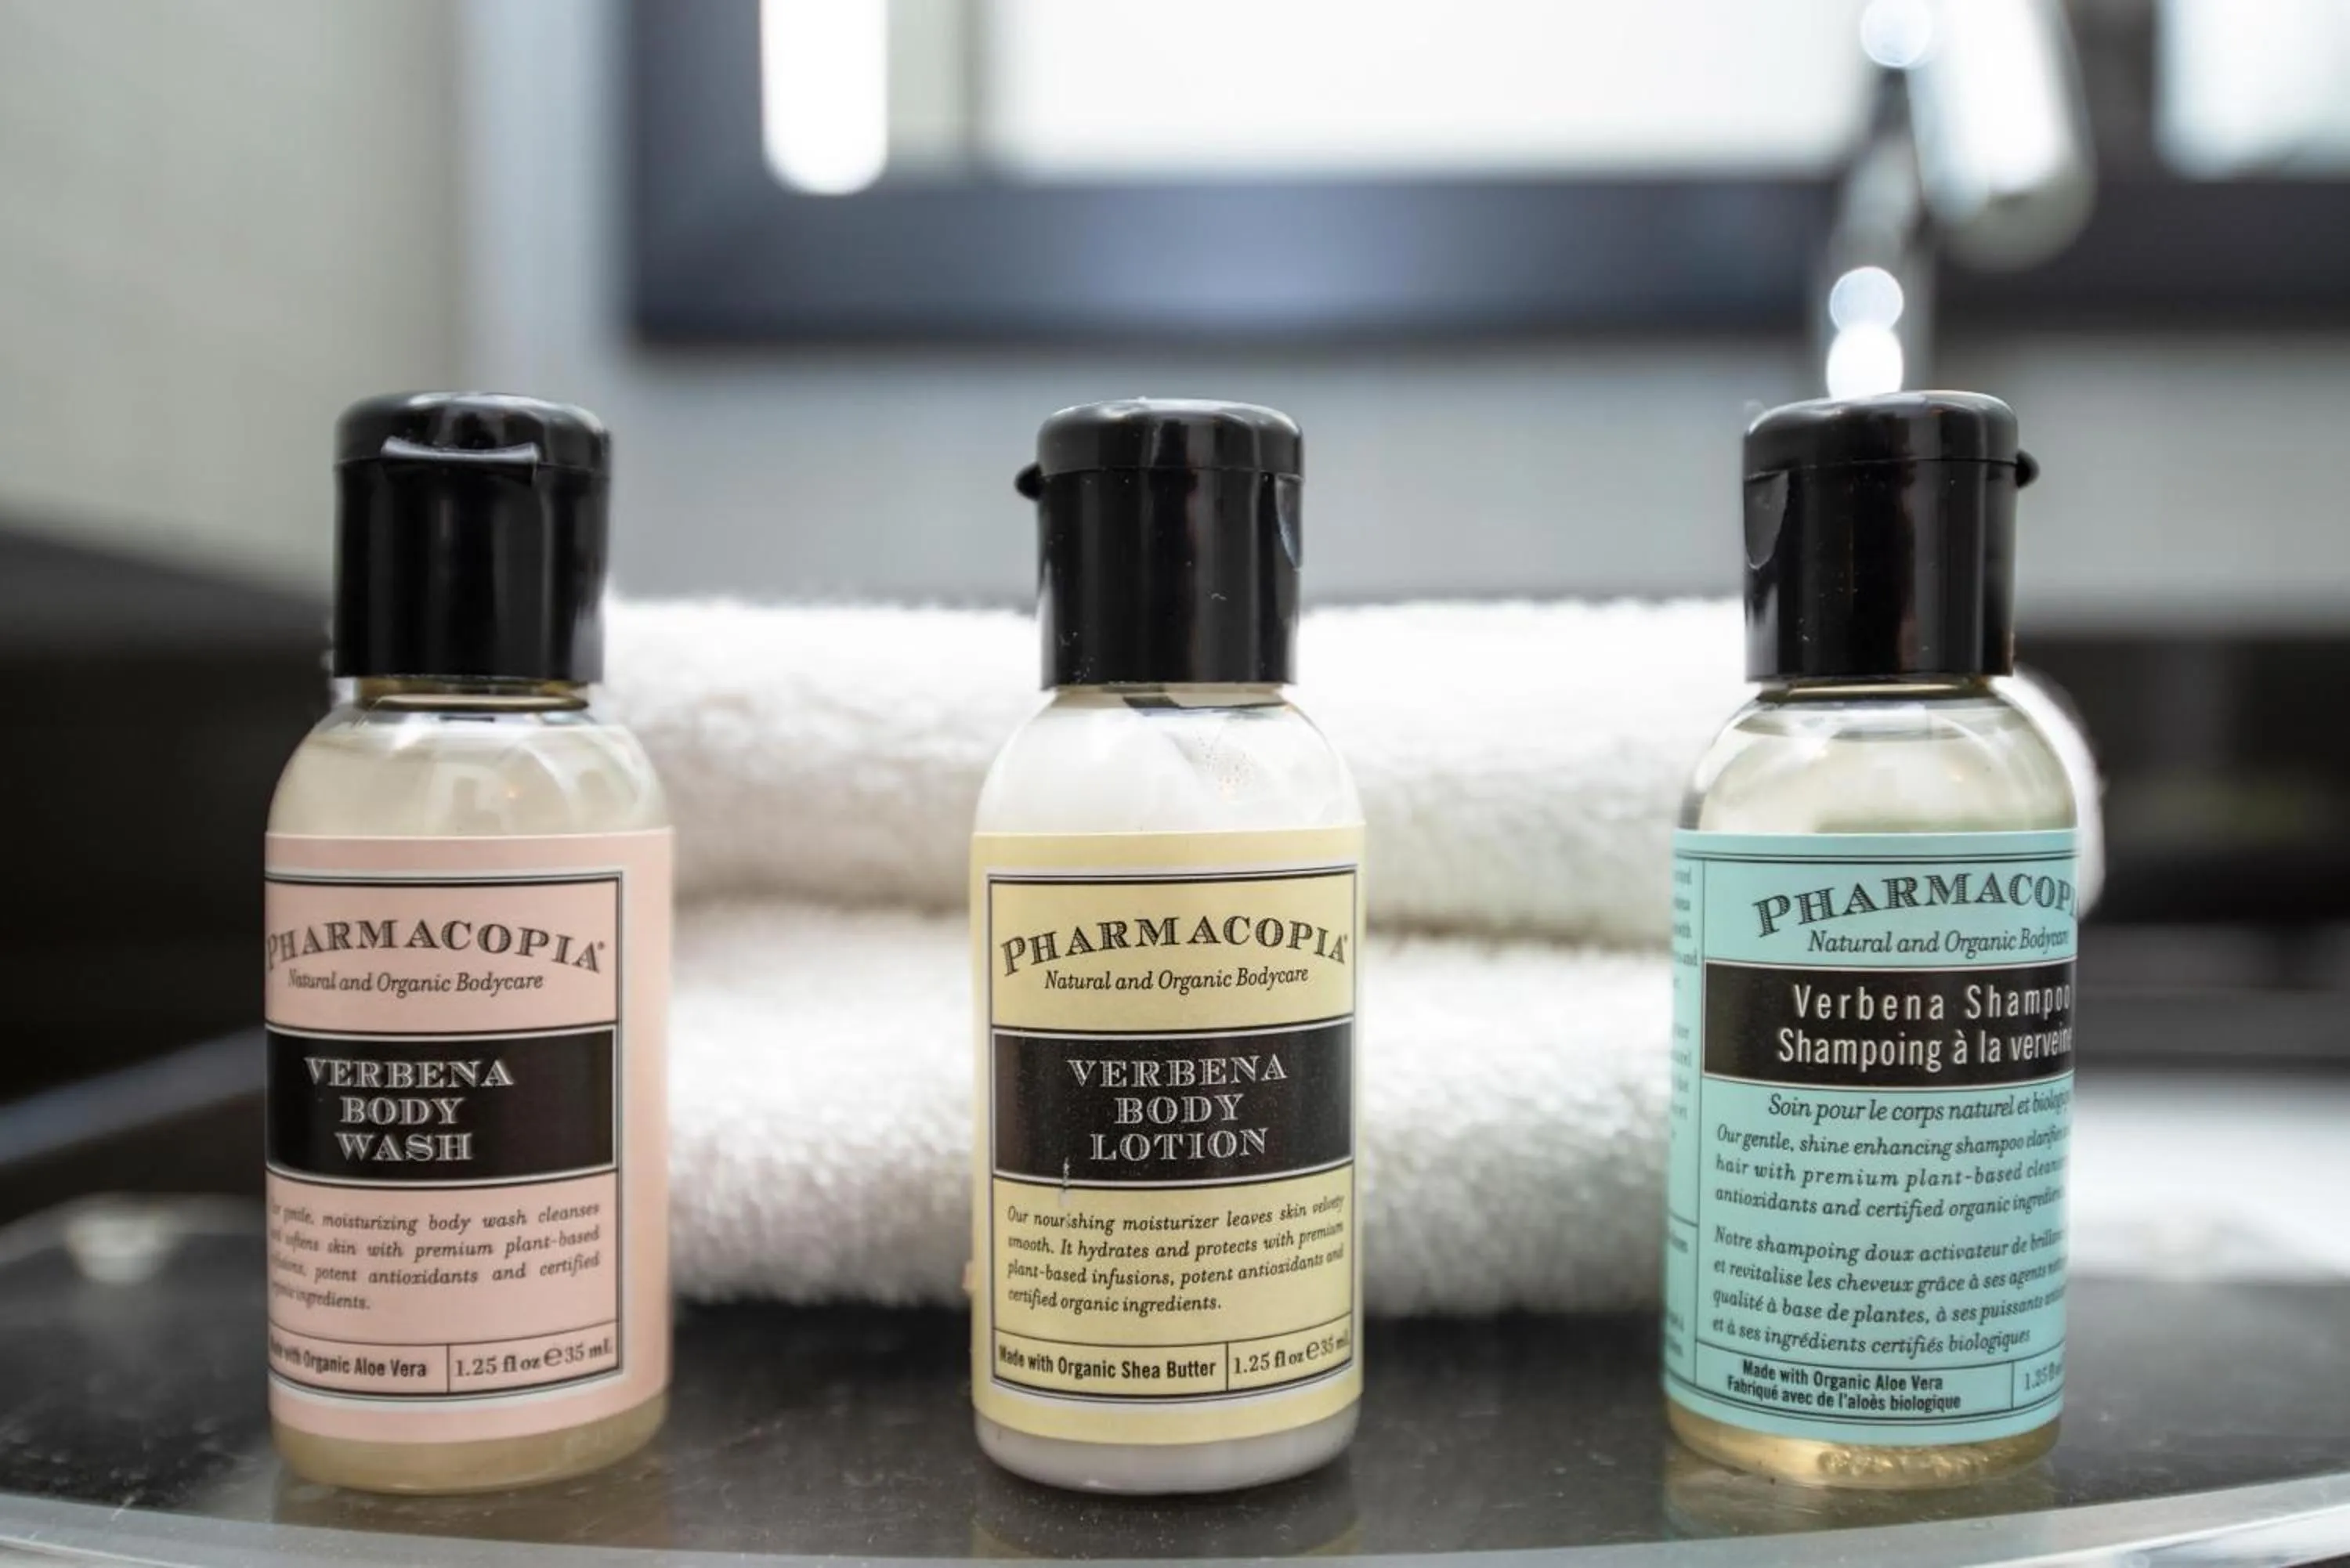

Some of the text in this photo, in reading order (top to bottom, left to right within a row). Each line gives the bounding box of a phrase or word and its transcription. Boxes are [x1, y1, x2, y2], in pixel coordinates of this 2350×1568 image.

[1808, 930, 1893, 953] Natural
[1896, 930, 1940, 954] and
[1943, 930, 2018, 960] Organic
[339, 971, 371, 992] and
[378, 973, 451, 999] Organic
[456, 972, 544, 997] Bodycare
[1044, 968, 1308, 995] Natural and Organic Bodycare
[1793, 983, 2070, 1021] Verbena Shampoo
[1777, 1027, 1943, 1072] Shampoing
[1953, 1029, 1969, 1064] à
[1979, 1026, 2001, 1064] la
[304, 1057, 514, 1089] VERBENA
[1068, 1053, 1287, 1088] VERBENA
[340, 1097, 465, 1124] BODY
[1115, 1094, 1244, 1124] BODY
[1769, 1093, 1813, 1117] Soin
[1816, 1100, 1867, 1129] pour
[1868, 1100, 1887, 1121] le
[1892, 1105, 1943, 1128] corps
[1949, 1096, 2015, 1119] naturel
[2017, 1100, 2030, 1117] et
[334, 1133, 472, 1161] WASH
[1090, 1129, 1268, 1161] LOTION
[1717, 1124, 1743, 1146] Our
[1743, 1128, 1795, 1152] gentle,
[1799, 1135, 1850, 1154] shine
[1854, 1139, 1952, 1160] enhancing
[1955, 1133, 2024, 1158] shampoo
[1716, 1154, 1749, 1174] hair
[1754, 1162, 1796, 1182] with
[1801, 1168, 1900, 1188] premium
[1905, 1161, 2022, 1194] plant-based
[323, 1215, 419, 1236] moisturizing
[428, 1216, 472, 1233] body
[483, 1212, 526, 1228] wash
[537, 1202, 600, 1223] cleanses
[1007, 1205, 1029, 1224] Our
[1123, 1215, 1220, 1230] moisturizer
[1227, 1210, 1274, 1228] leaves
[1280, 1204, 1307, 1222] skin
[1716, 1188, 1817, 1213] antioxidants
[1822, 1198, 1860, 1216] and
[1866, 1199, 1944, 1222] certified
[1949, 1197, 2011, 1221] organic
[328, 1238, 356, 1255] skin
[367, 1241, 404, 1257] with
[414, 1242, 494, 1263] premium
[504, 1227, 599, 1259] plant-based
[1061, 1239, 1073, 1255] It
[1078, 1239, 1149, 1259] hydrates
[1155, 1242, 1190, 1258] and
[1194, 1237, 1257, 1261] protects
[1263, 1231, 1295, 1249] with
[1715, 1227, 1753, 1250] Notre
[1757, 1234, 1858, 1266] shampoing
[1865, 1243, 1914, 1261] doux
[1919, 1241, 2007, 1261] activateur
[2012, 1239, 2027, 1255] de
[314, 1253, 599, 1284] potent antioxidants and certified
[1007, 1259, 1086, 1284] plant-based
[1091, 1267, 1175, 1289] infusions,
[1180, 1267, 1234, 1288] potent
[1238, 1254, 1324, 1280] antioxidants
[1715, 1258, 1726, 1274] et
[1729, 1261, 1802, 1286] revitalise
[1806, 1269, 1832, 1288] les
[1837, 1274, 1914, 1292] cheveux
[1916, 1274, 1965, 1296] grâce
[1969, 1274, 1979, 1291] à
[1983, 1274, 2006, 1288] ses
[2008, 1263, 2046, 1287] agents
[1007, 1288, 1221, 1317] certified organic ingredients.
[1713, 1287, 2043, 1327] qualité à base de plantes, à ses puissants
[1713, 1318, 2030, 1359] et à ses ingrédients certifiés biologiques
[303, 1349, 351, 1374] Organic
[354, 1358, 385, 1376] Aloe
[390, 1360, 426, 1377] Vera
[456, 1357, 497, 1377] 1.25
[520, 1358, 541, 1370] oz
[565, 1345, 584, 1363] 35
[1027, 1349, 1054, 1374] with
[1058, 1354, 1116, 1379] Organic
[1122, 1357, 1161, 1378] Shea
[1166, 1360, 1217, 1379] Butter
[1234, 1352, 1271, 1374] 1.25
[1289, 1352, 1303, 1364] oz
[1744, 1359, 1943, 1393] Made with Organic Aloe Vera
[1727, 1375, 1961, 1413] Fabriqué avec de l'aloès biologique
